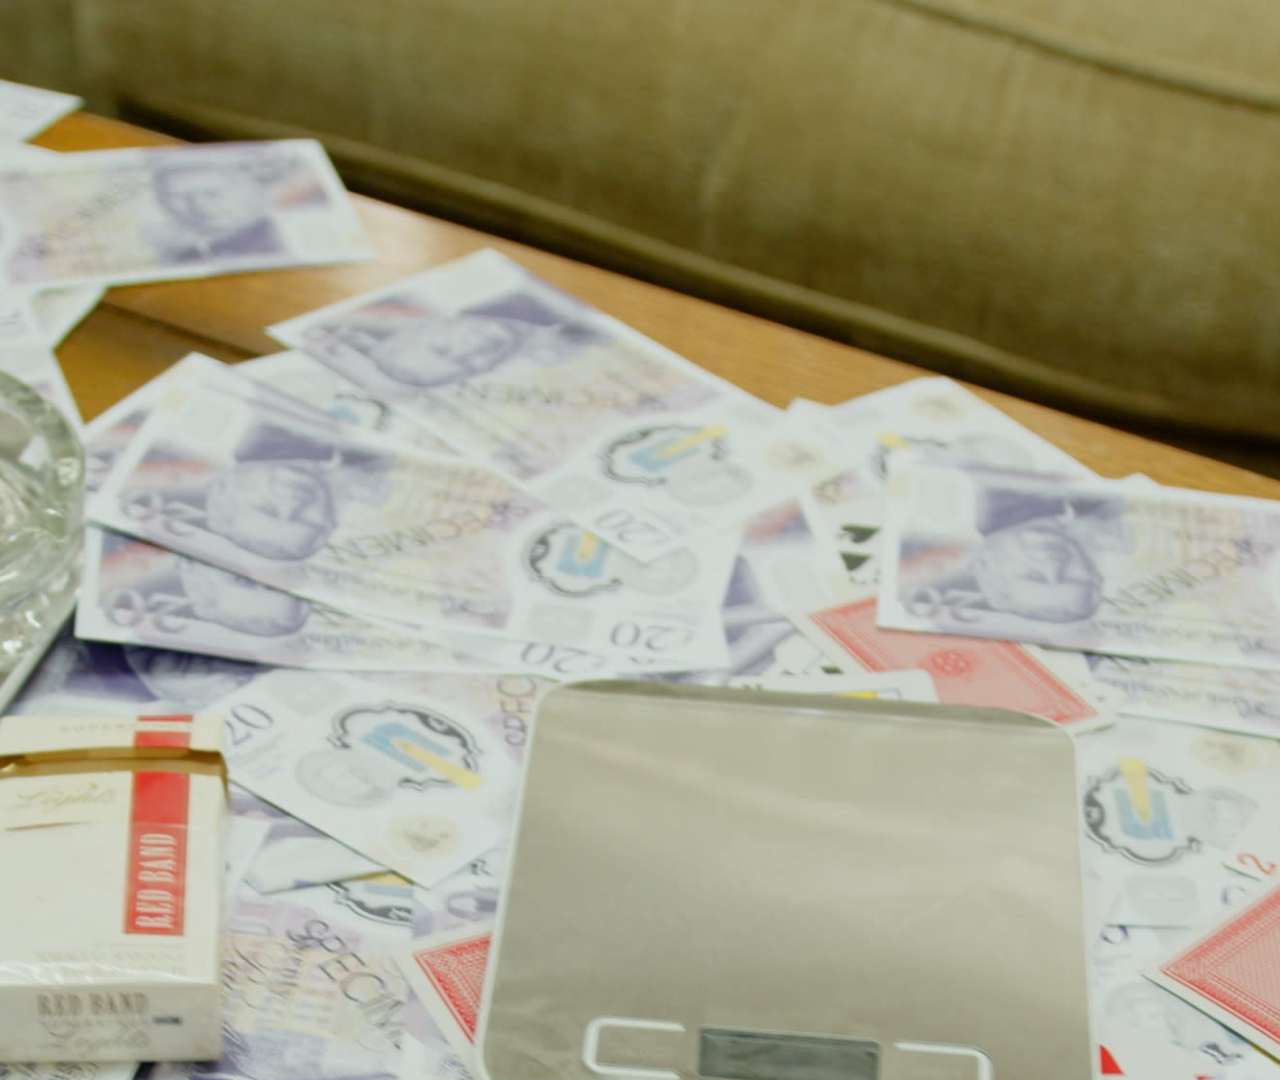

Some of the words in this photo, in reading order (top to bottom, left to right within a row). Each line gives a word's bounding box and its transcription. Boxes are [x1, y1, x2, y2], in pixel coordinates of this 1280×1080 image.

[138, 833, 178, 883] BAND
[1237, 852, 1277, 876] 2
[134, 888, 175, 929] RED
[37, 993, 84, 1016] RED
[91, 993, 148, 1016] BAND
